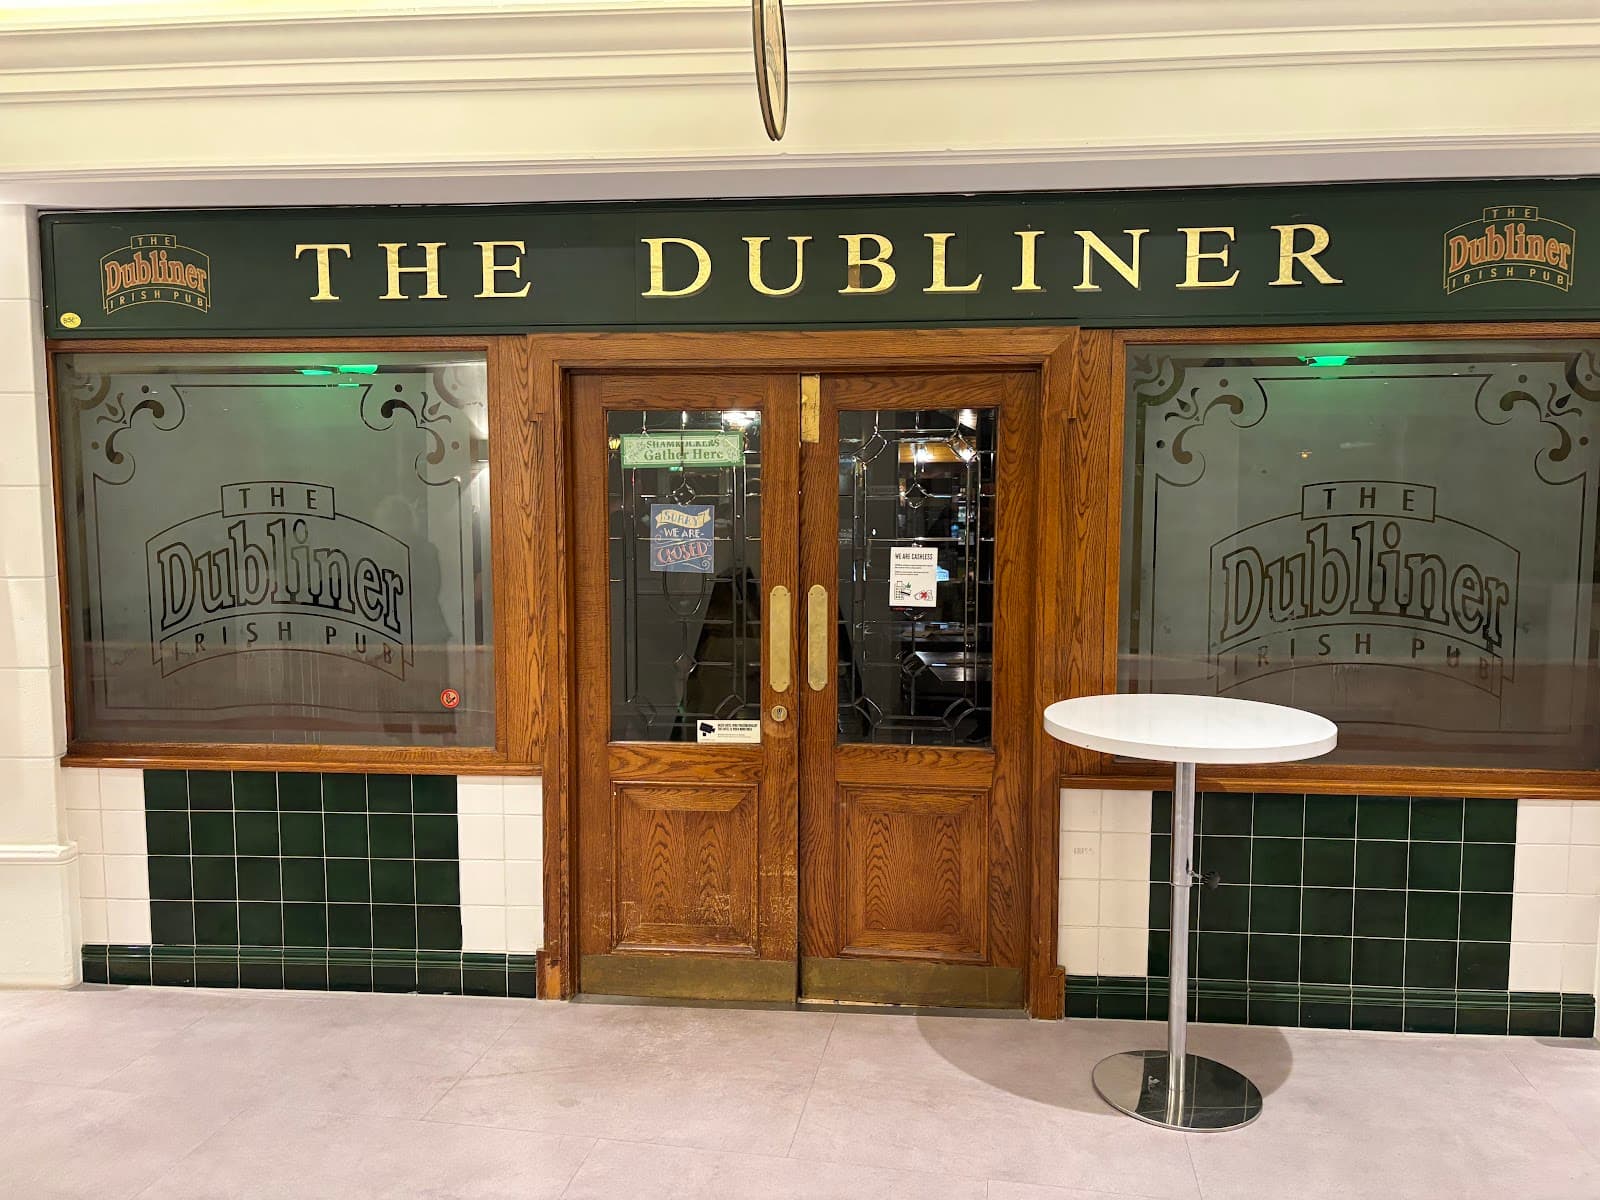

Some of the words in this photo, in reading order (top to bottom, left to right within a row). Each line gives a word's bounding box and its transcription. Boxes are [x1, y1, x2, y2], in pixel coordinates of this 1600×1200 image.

[1492, 208, 1532, 218] THE
[136, 236, 171, 246] THE
[1449, 223, 1571, 273] Dubliner
[105, 250, 208, 296] Dubliner
[295, 240, 532, 301] THE
[641, 224, 1344, 299] DUBLINER
[1452, 266, 1514, 288] IRISH
[1530, 268, 1564, 285] PUB
[110, 290, 161, 309] IRISH
[173, 291, 203, 307] PUB
[644, 448, 689, 461] Gather
[692, 449, 724, 460] Here
[238, 488, 318, 510] THE
[1322, 487, 1415, 512] THE
[663, 527, 680, 537] WE
[656, 541, 708, 564] CLOSED
[157, 518, 403, 634] Dubliner
[1220, 521, 1509, 648] Dubliner
[175, 622, 292, 661] IRISH
[325, 626, 393, 664] PUB
[1233, 634, 1371, 676] IRISH
[1411, 639, 1488, 680] PUB
